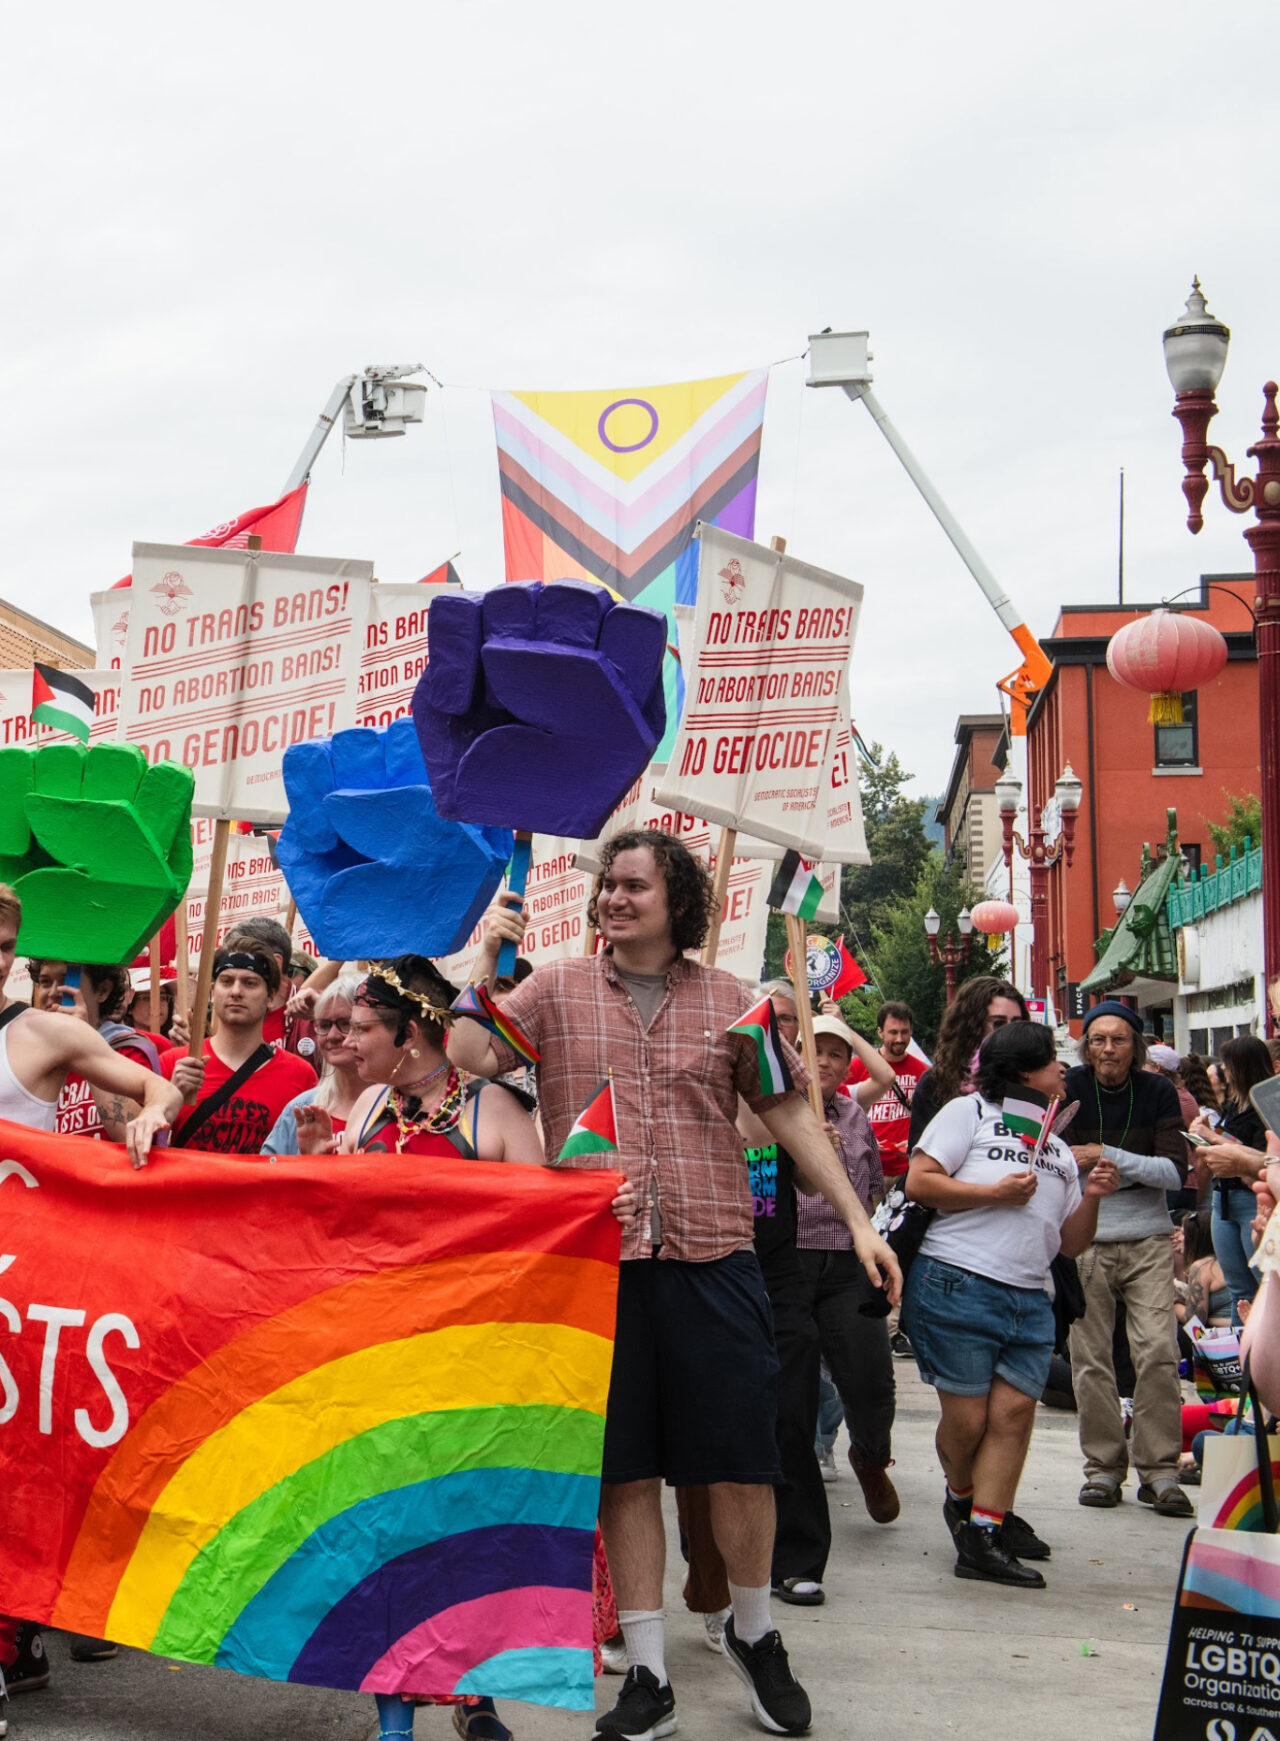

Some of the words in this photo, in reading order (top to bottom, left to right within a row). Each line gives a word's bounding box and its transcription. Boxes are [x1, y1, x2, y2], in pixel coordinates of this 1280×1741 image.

[144, 622, 176, 657] NO
[186, 602, 264, 648] TRANS
[273, 581, 349, 628] BANS!
[366, 620, 388, 649] NS
[706, 612, 732, 645] NO
[734, 609, 792, 643] TRANS
[795, 606, 853, 639] BANS!
[138, 685, 166, 714] NO
[172, 661, 274, 706] ABORTION
[281, 643, 341, 682] BANS!
[696, 677, 715, 704] NO
[791, 670, 843, 697] BANS!
[182, 702, 336, 768] GENOCIDE!
[679, 737, 707, 776] NO
[713, 729, 831, 774] GENOCIDE!
[249, 857, 273, 875] BAN
[189, 903, 200, 918] NO
[533, 883, 585, 914] ABORTION
[896, 1075, 917, 1086] RATIC
[1187, 1627, 1234, 1644] HELPING
[1183, 1697, 1219, 1710] across
[1221, 1701, 1235, 1712] OR
[1237, 1704, 1245, 1714] &
